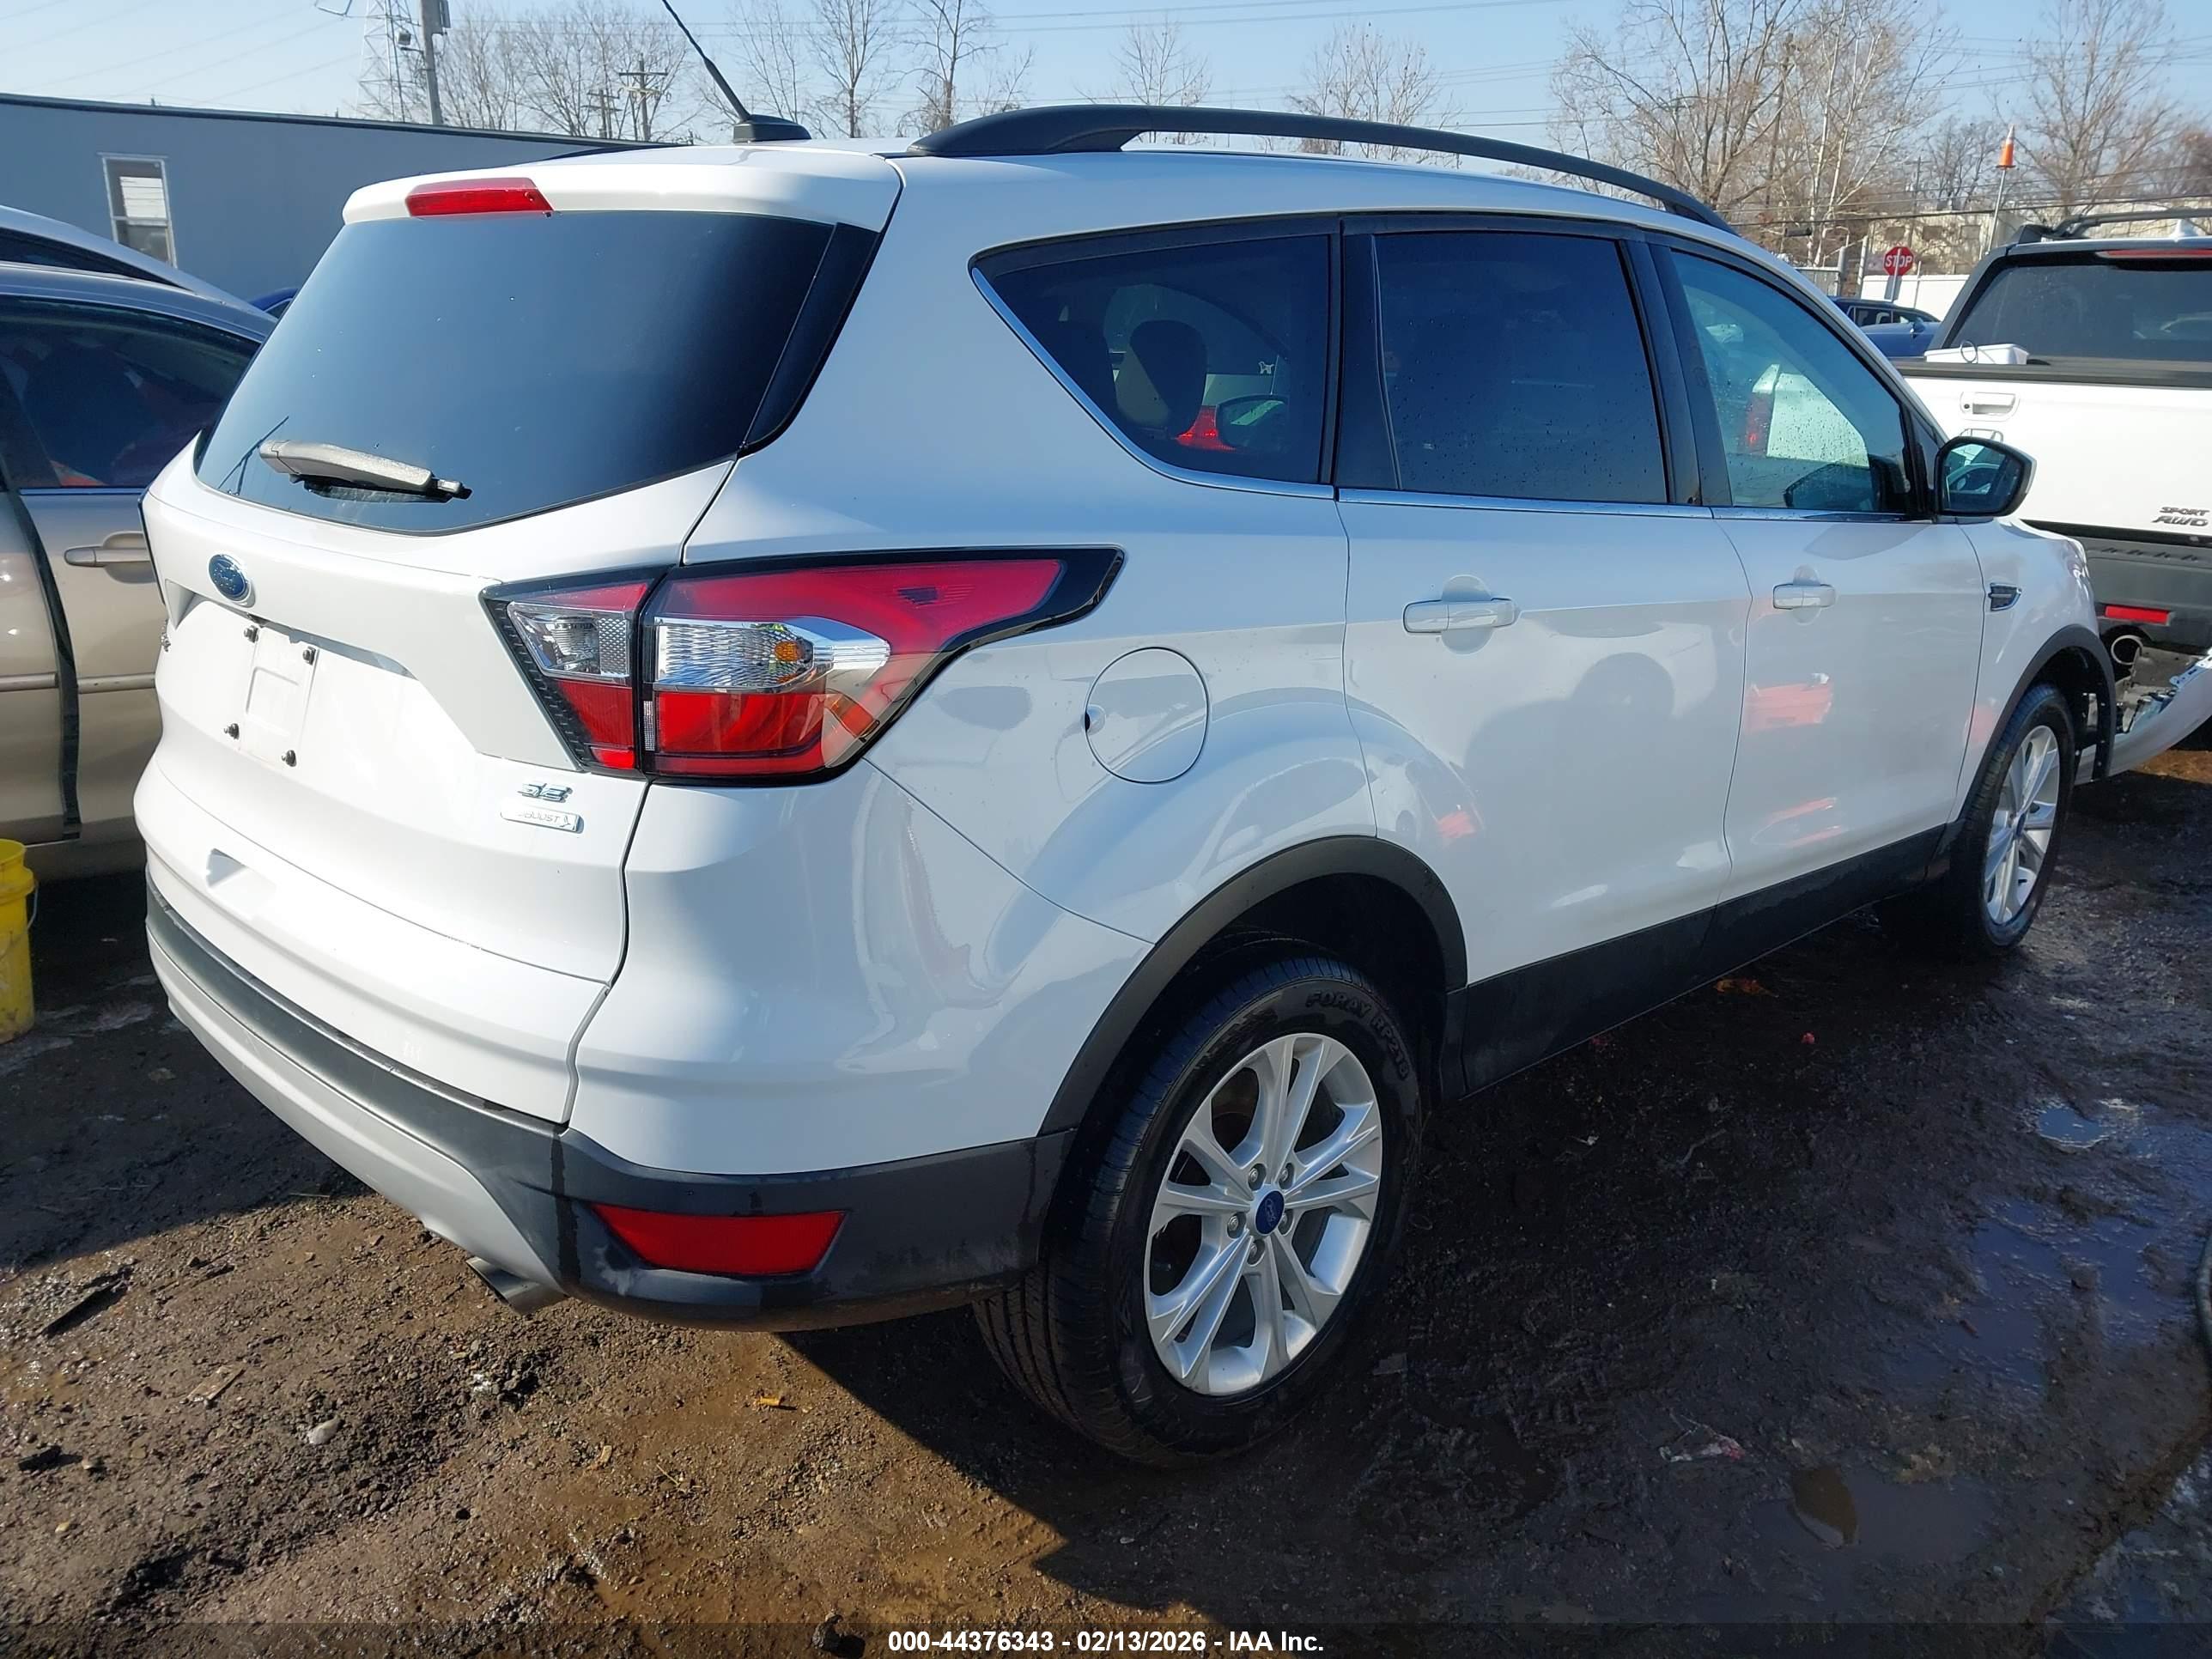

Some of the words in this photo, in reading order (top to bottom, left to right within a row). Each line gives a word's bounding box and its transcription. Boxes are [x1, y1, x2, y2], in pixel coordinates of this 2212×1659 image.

[1885, 255, 1913, 268] STOP
[2159, 507, 2210, 516] SPORT
[2151, 515, 2209, 526] AWD
[517, 782, 574, 803] SE
